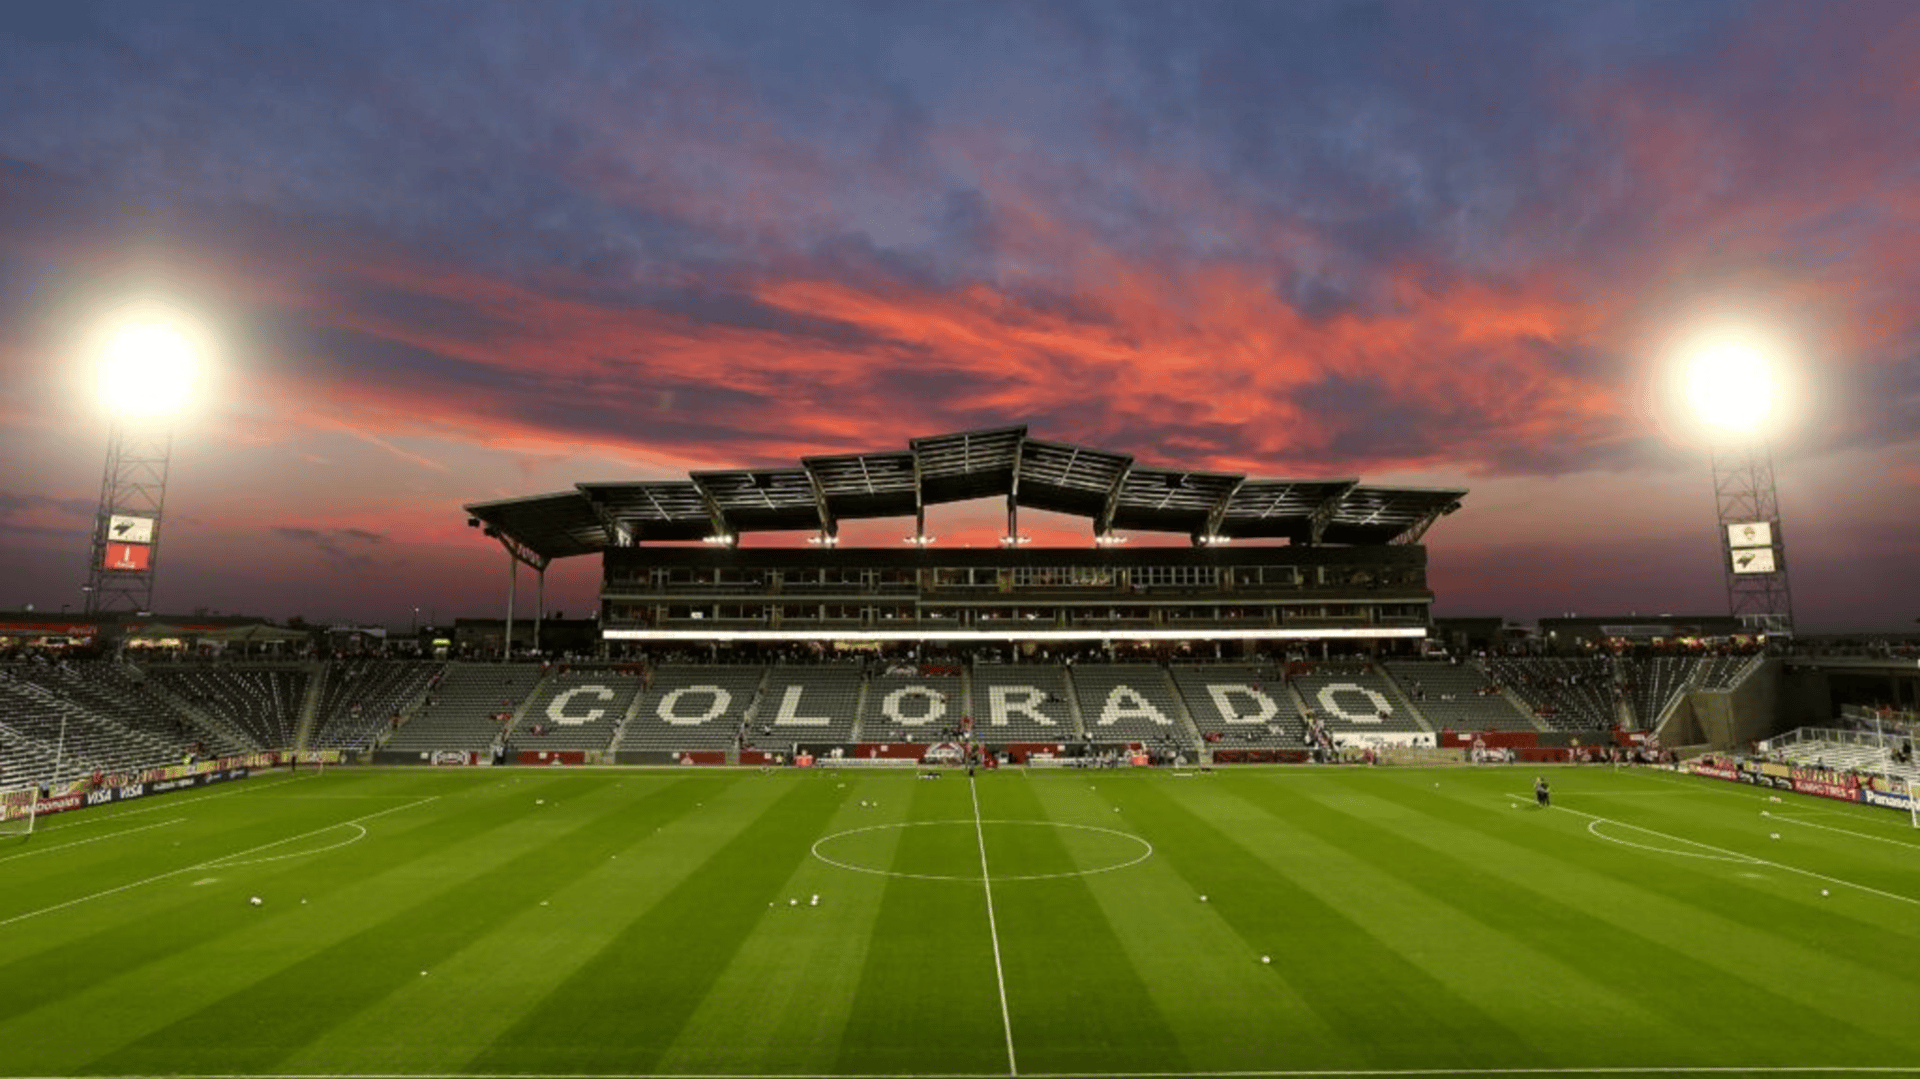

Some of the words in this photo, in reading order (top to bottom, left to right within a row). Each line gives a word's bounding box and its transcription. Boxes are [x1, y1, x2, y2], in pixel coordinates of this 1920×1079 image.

[545, 683, 1394, 727] COLORADO
[87, 788, 112, 804] VISA
[119, 783, 143, 799] VISA
